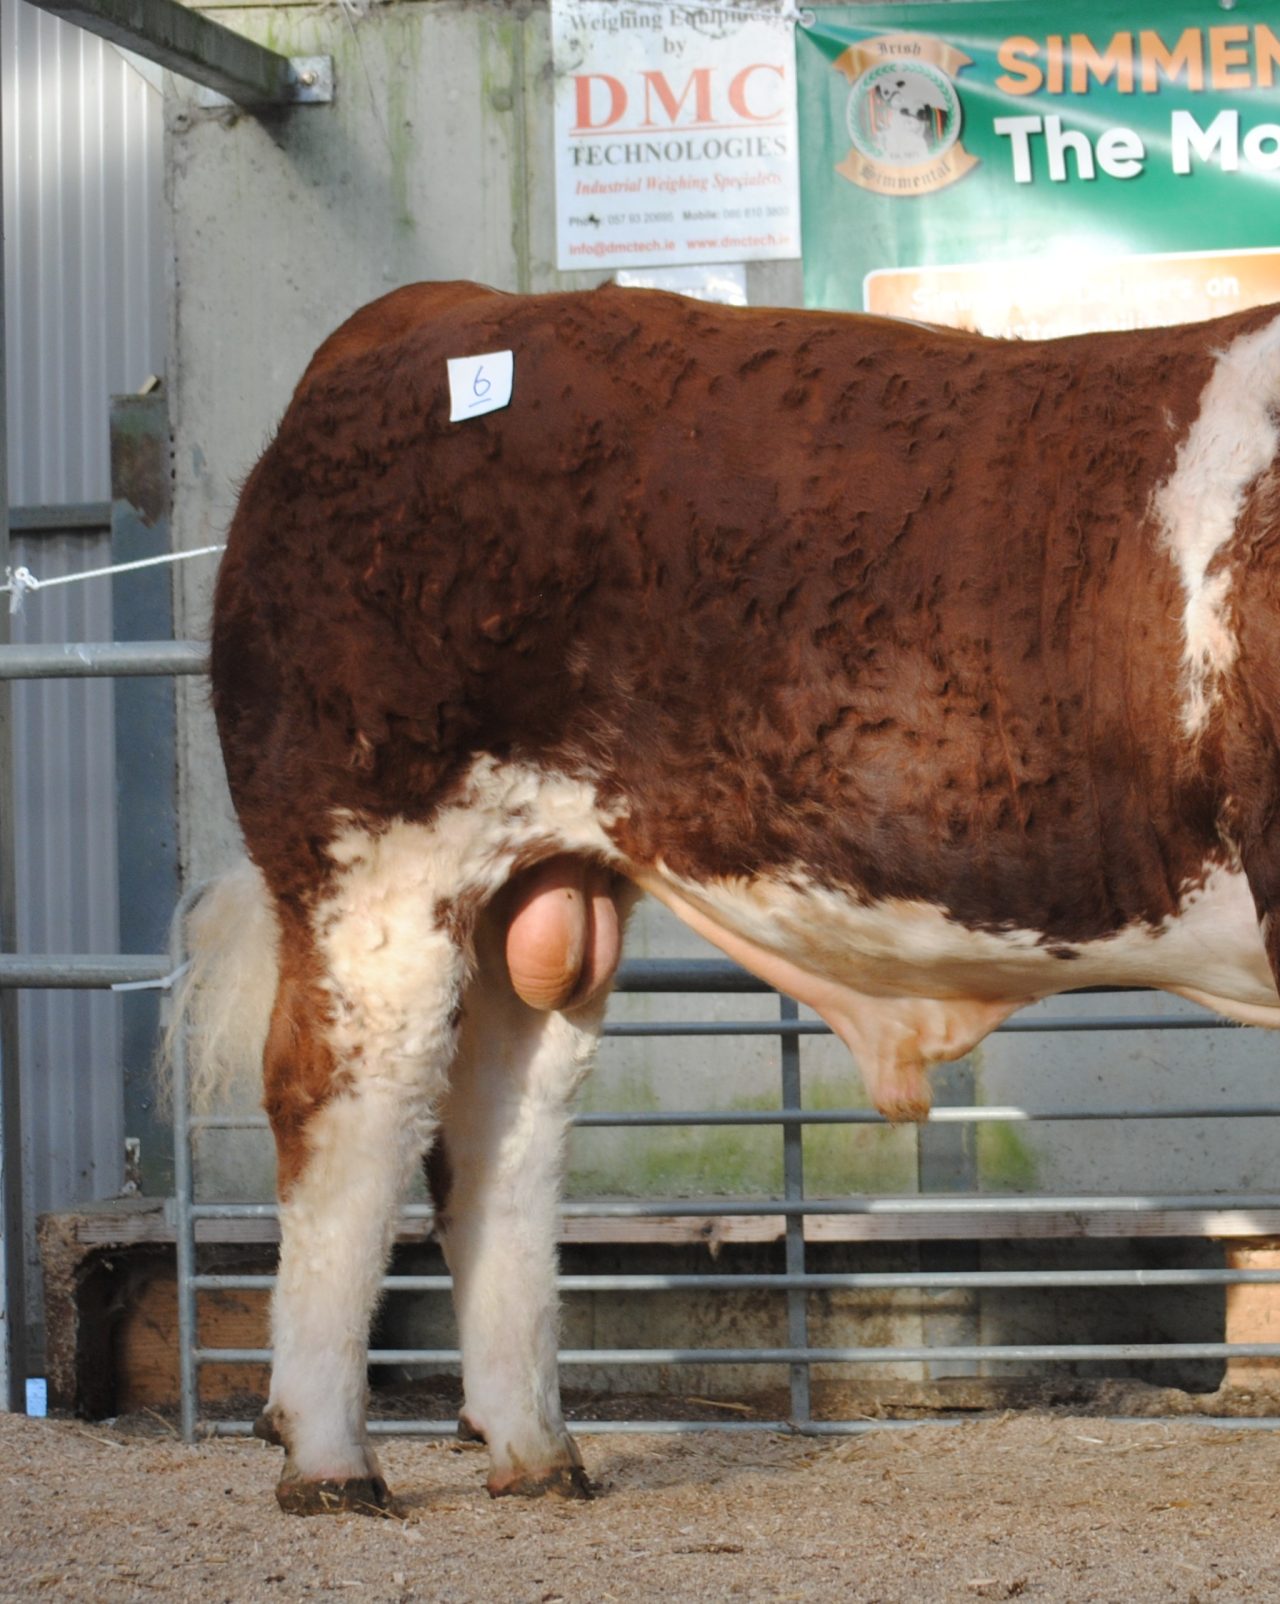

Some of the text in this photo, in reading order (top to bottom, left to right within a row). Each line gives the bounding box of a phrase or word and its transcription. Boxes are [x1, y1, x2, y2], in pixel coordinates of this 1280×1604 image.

[570, 9, 663, 35] Weighing
[663, 36, 687, 57] by
[879, 42, 923, 56] Irish
[571, 63, 786, 129] DMC
[569, 137, 787, 167] TECHNOLOGIES
[993, 113, 1145, 183] The
[575, 177, 642, 195] Industrial
[646, 174, 709, 193] Weighing
[860, 160, 952, 189] Simmental
[569, 238, 676, 257] info@dmctech.ie
[473, 364, 492, 397] 6
